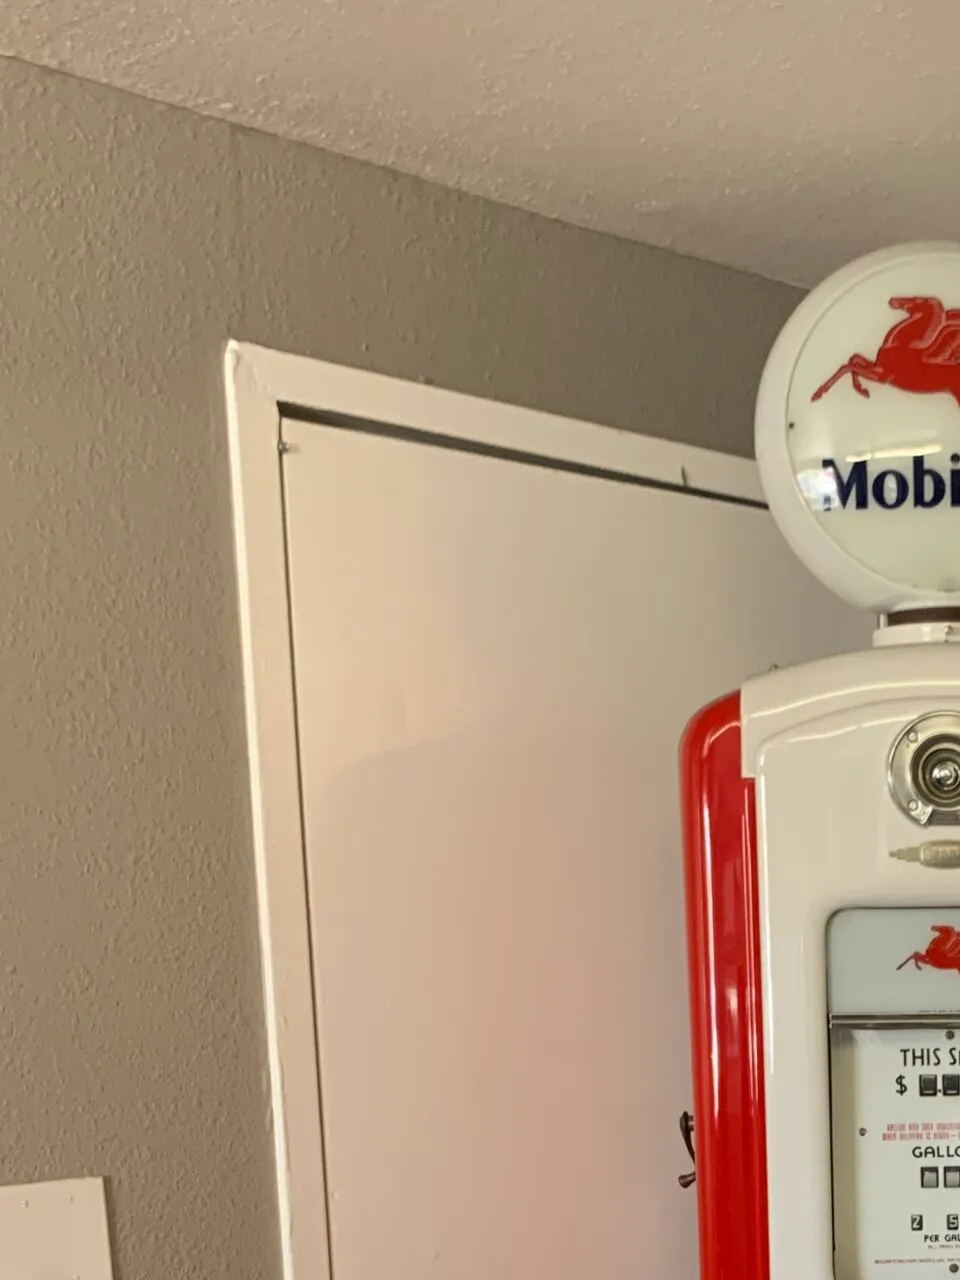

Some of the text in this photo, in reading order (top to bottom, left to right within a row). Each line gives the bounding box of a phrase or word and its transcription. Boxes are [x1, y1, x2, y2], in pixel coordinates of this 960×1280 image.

[900, 1048, 941, 1067] THIS
[895, 1074, 907, 1096] $
[911, 1215, 922, 1230] 2
[948, 1214, 958, 1229] 5
[924, 1234, 939, 1243] PER
